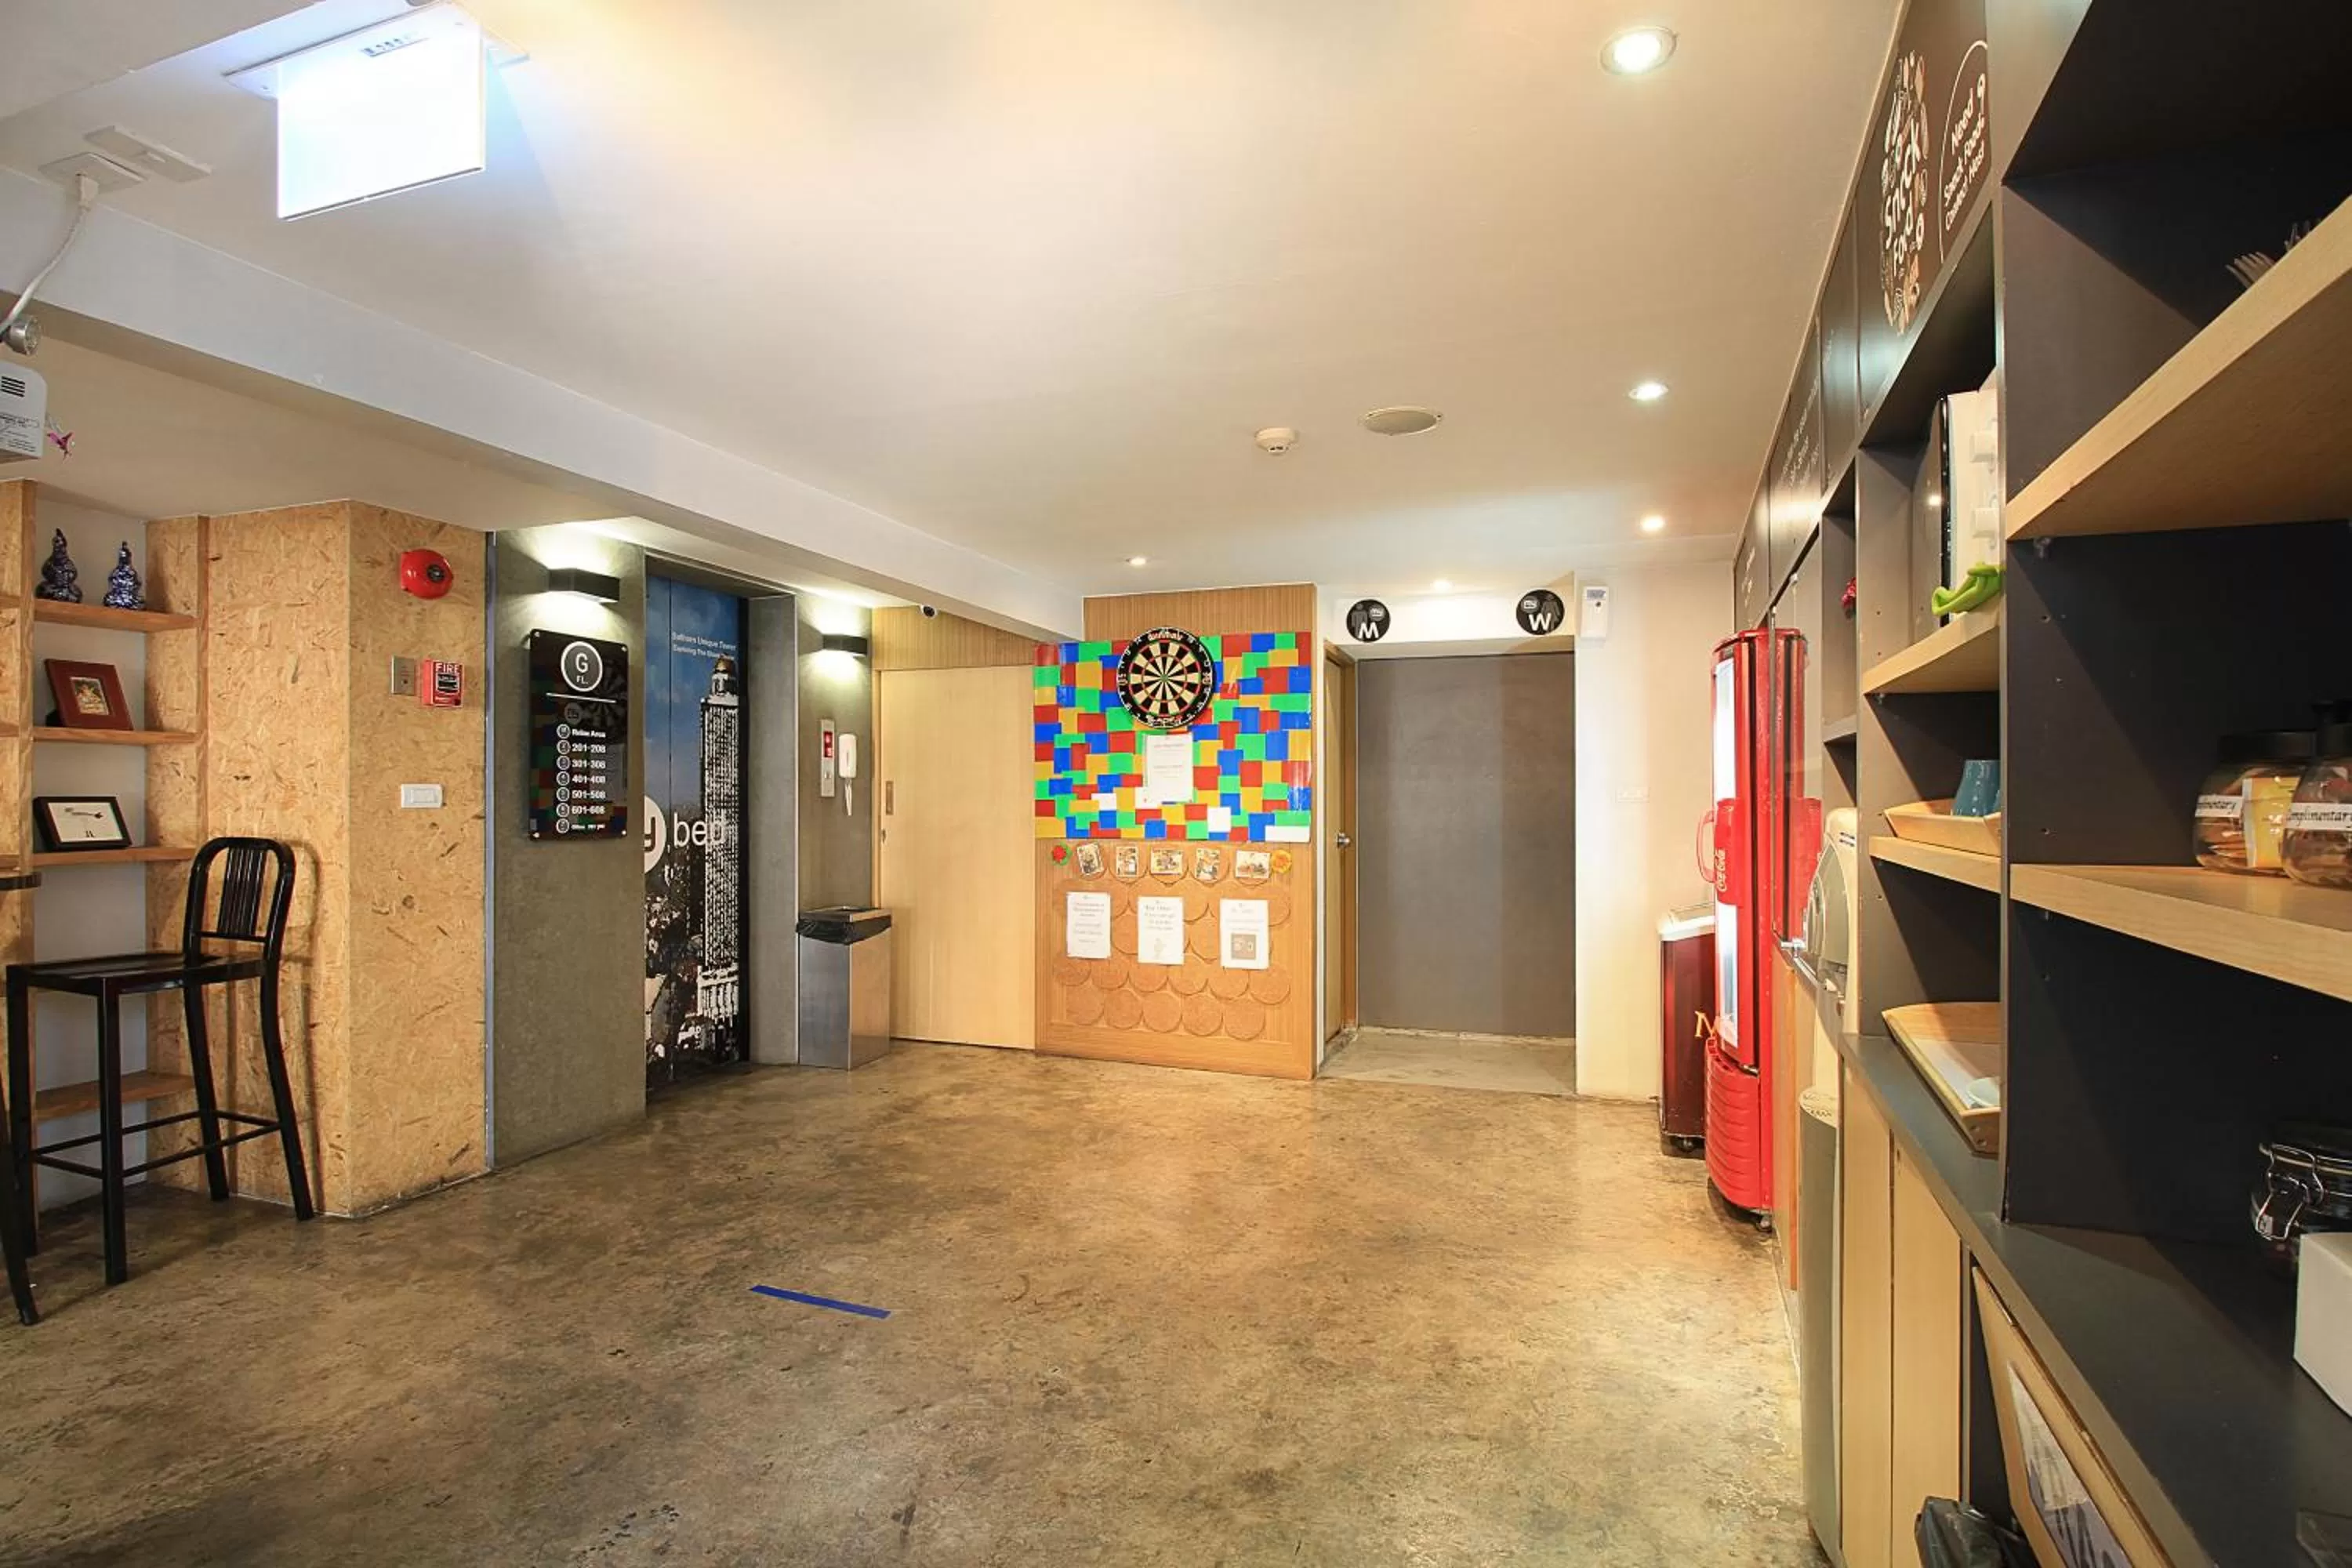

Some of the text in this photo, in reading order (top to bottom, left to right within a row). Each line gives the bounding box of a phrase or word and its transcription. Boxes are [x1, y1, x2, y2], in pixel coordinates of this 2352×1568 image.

[1359, 622, 1379, 639] M
[1529, 613, 1552, 631] W
[435, 662, 459, 673] FIRE
[575, 652, 588, 673] G
